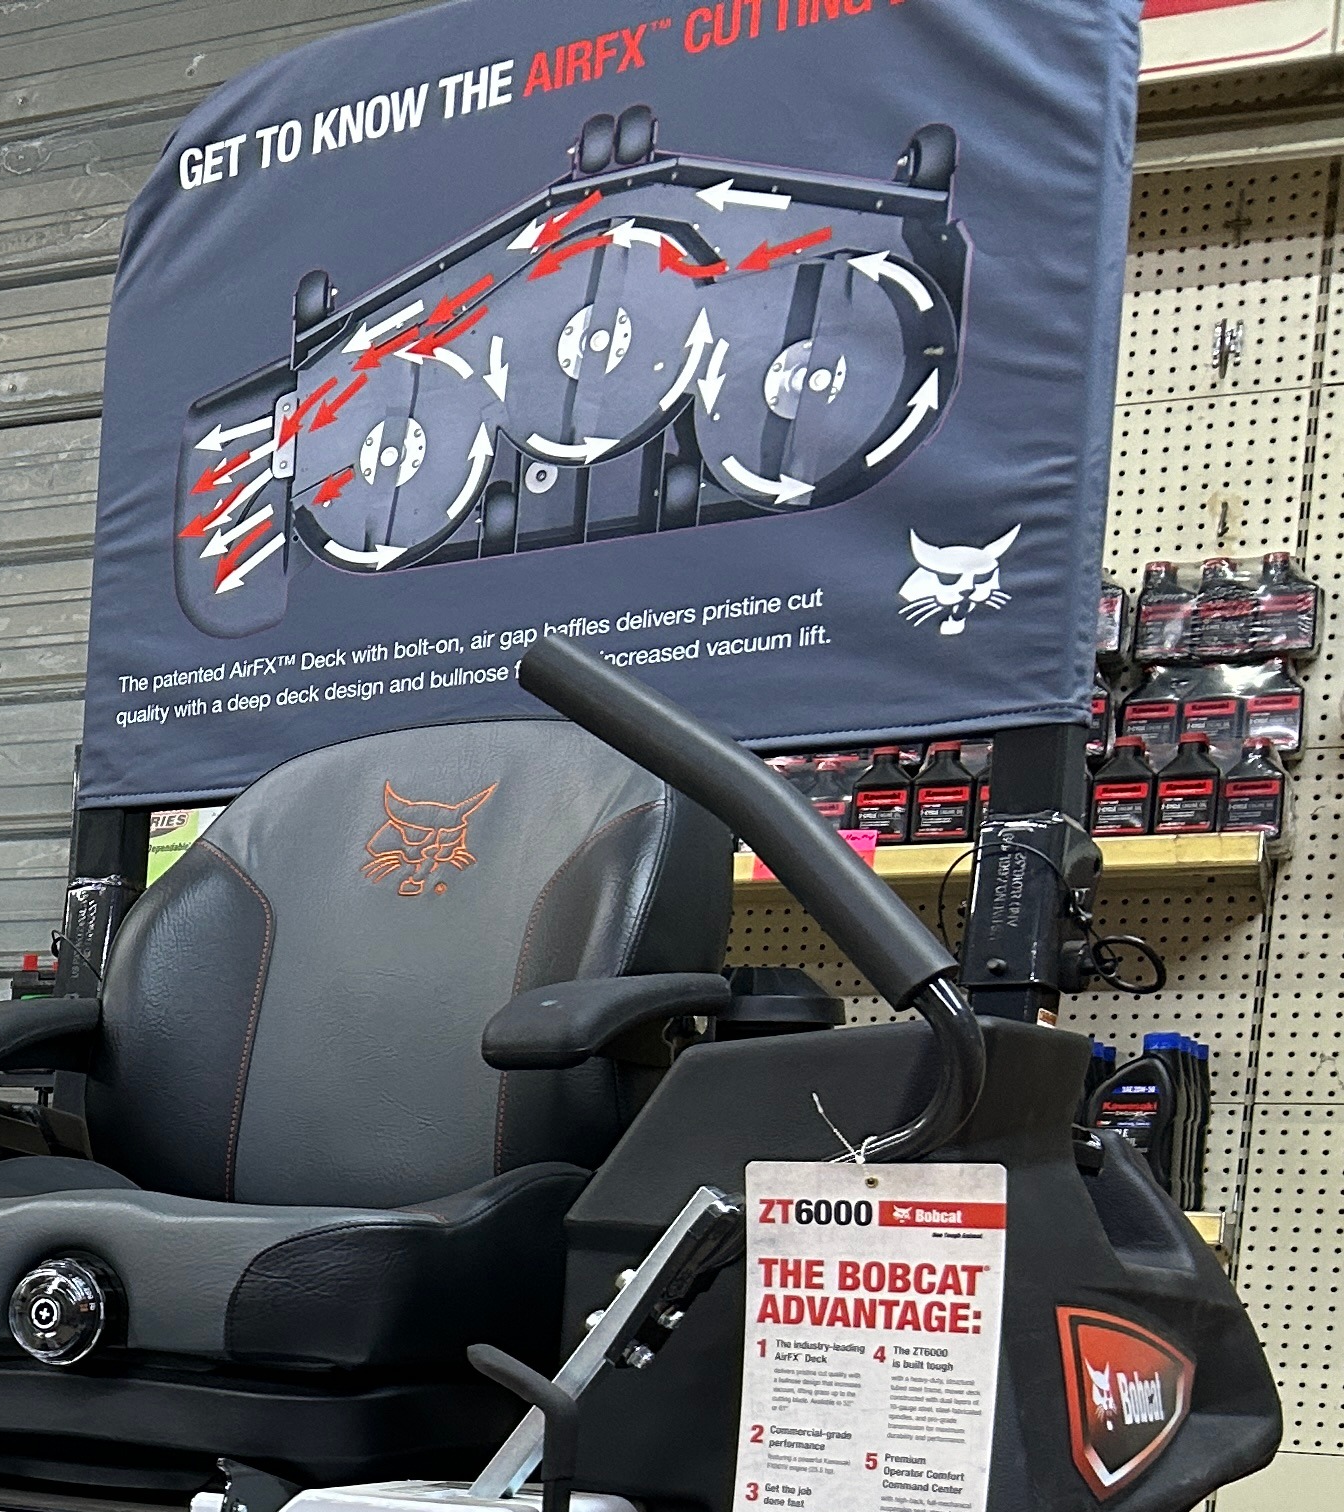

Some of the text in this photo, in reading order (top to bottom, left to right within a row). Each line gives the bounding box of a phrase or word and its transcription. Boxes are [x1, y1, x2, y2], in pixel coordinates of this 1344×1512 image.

[178, 134, 247, 190] GET
[255, 120, 302, 169] TO
[312, 83, 429, 155] KNOW
[438, 59, 514, 120] THE
[118, 675, 149, 693] The
[153, 664, 225, 693] patented
[301, 649, 346, 671] Deck
[351, 644, 388, 665] with
[393, 637, 465, 660] bolt-on,
[470, 631, 495, 650] air
[499, 626, 538, 649] gap
[616, 608, 696, 633] delivers
[701, 597, 782, 626] pristine
[787, 588, 824, 611] cut
[116, 706, 170, 728] quality
[174, 698, 207, 719] with
[211, 699, 223, 714] a
[227, 692, 273, 712] deep
[276, 686, 320, 707] deck
[324, 678, 384, 702] design
[389, 672, 424, 694] and
[429, 666, 509, 691] bullnose
[599, 644, 699, 668] ncreased
[706, 633, 792, 657] vacuum
[799, 625, 832, 647] lift.
[151, 813, 187, 828] RIES
[759, 1198, 873, 1226] ZT6000
[914, 1208, 962, 1224] Bobcat
[758, 1257, 824, 1290] THE
[756, 1293, 981, 1335] ADVANTAGE:
[757, 1338, 766, 1358] 1
[776, 1339, 791, 1348] The
[893, 1346, 948, 1357] The ZT6000
[805, 1353, 827, 1363] Deck
[873, 1346, 886, 1363] 4
[892, 1359, 953, 1372] is built tough
[1116, 1371, 1164, 1425] Bobcat
[750, 1424, 764, 1443] 2
[770, 1425, 852, 1440] Commercial-grade
[769, 1439, 825, 1450] performance
[865, 1453, 878, 1470] 5
[885, 1453, 926, 1464] Premium
[883, 1466, 964, 1481] Operator Comfort
[745, 1482, 759, 1501] 3
[765, 1483, 812, 1496] Get the job
[882, 1479, 963, 1494] Command Center
[764, 1496, 804, 1508] done fast
